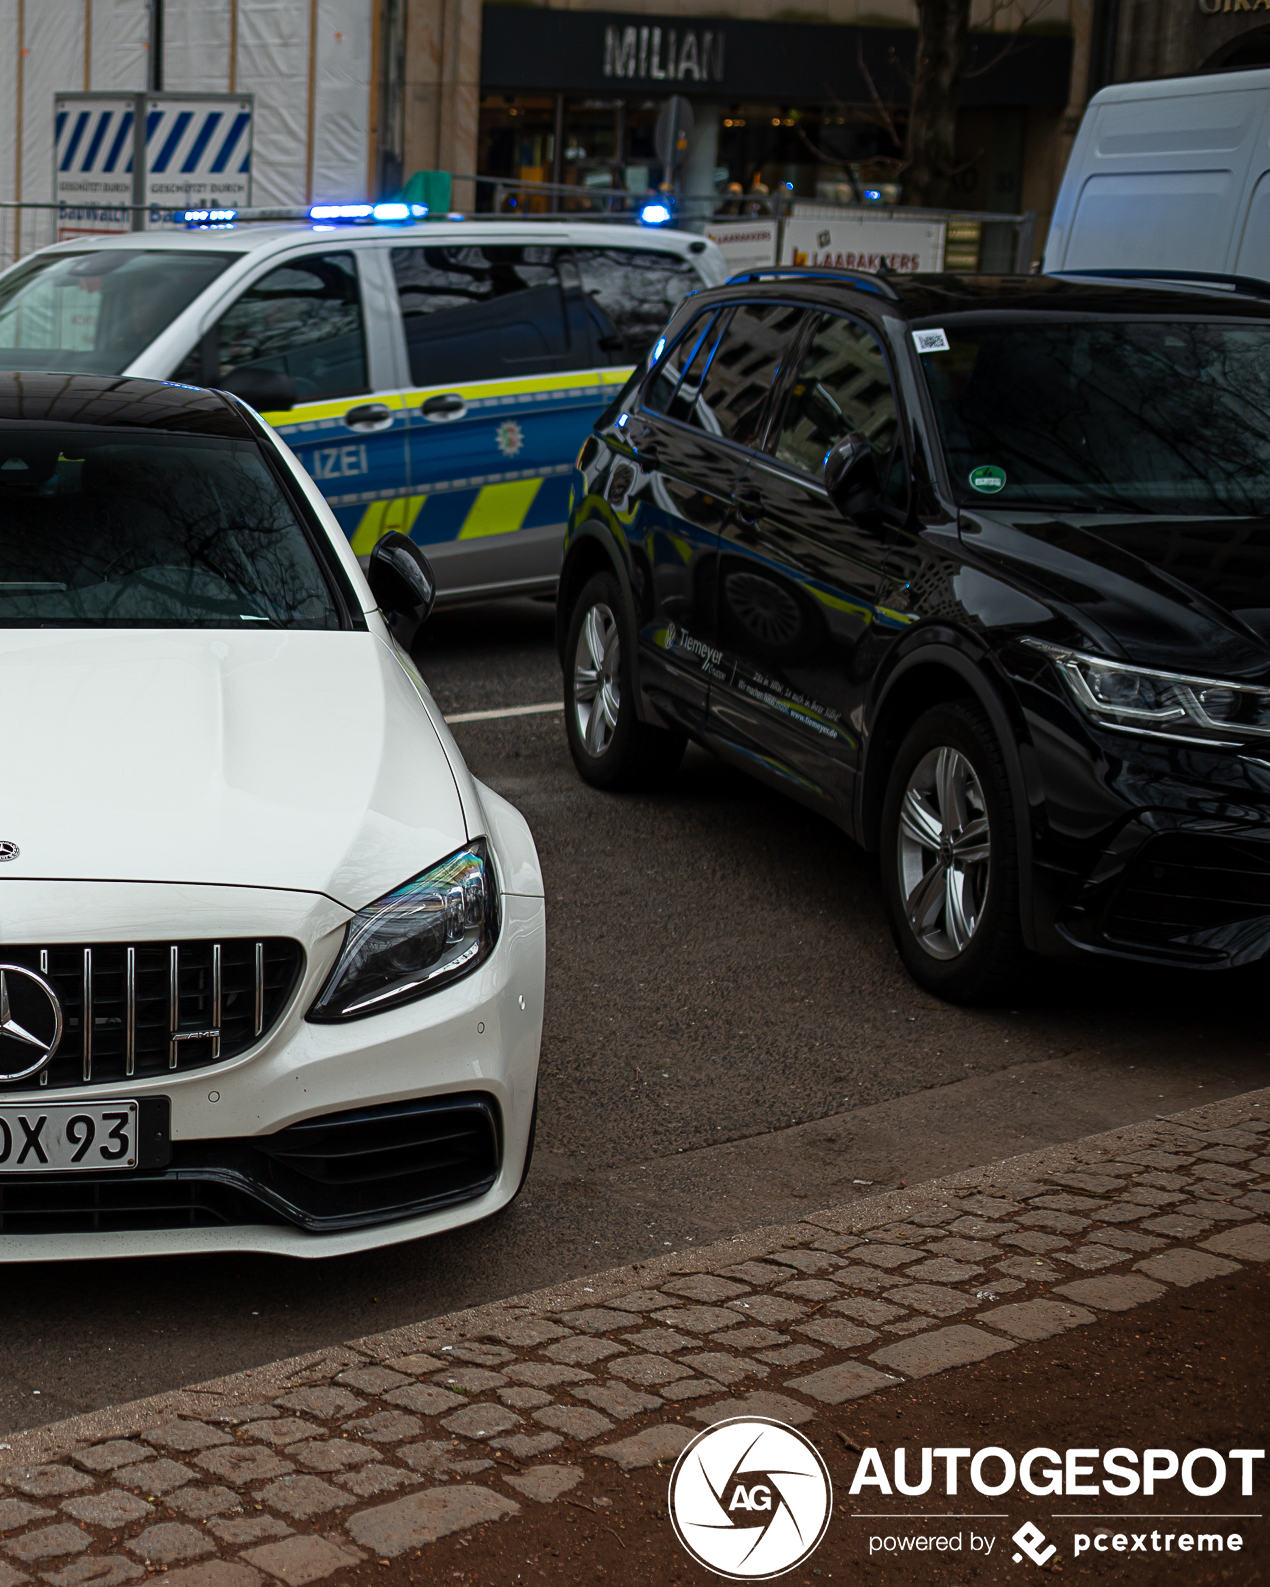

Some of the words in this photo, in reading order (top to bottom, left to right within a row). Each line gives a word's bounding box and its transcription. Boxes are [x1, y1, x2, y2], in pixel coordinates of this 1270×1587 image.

[603, 24, 725, 82] MILIAN
[210, 184, 245, 194] DURCH
[679, 627, 724, 670] Tiemeyer
[790, 710, 838, 739] www.tiemeyer.de
[66, 1112, 130, 1163] 93
